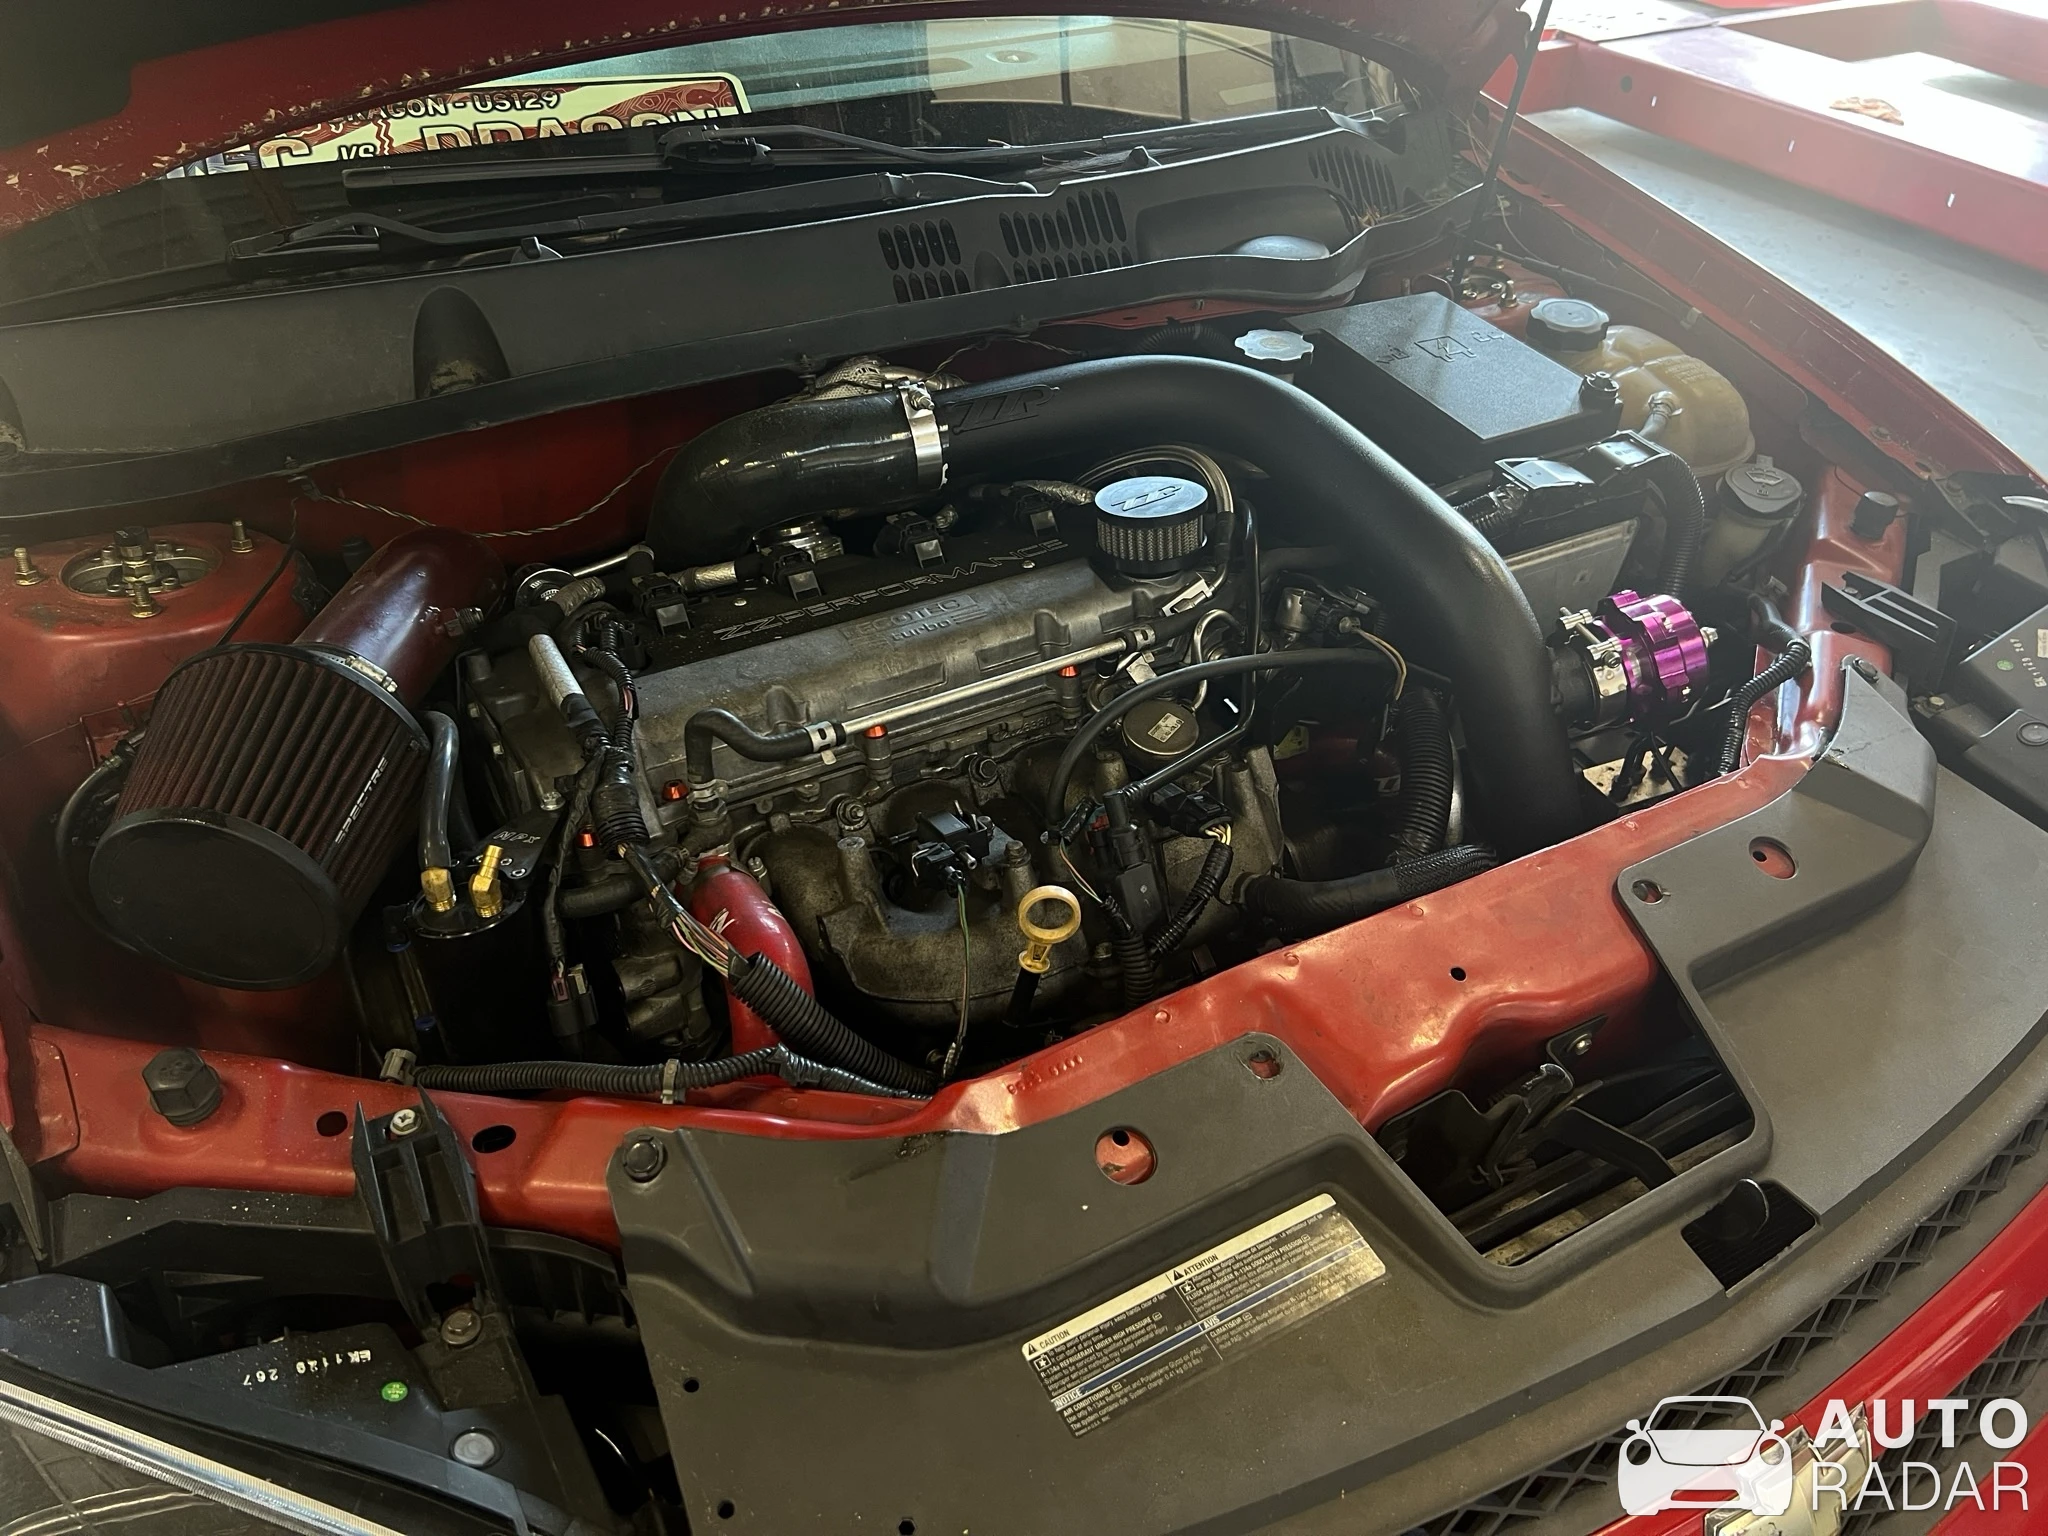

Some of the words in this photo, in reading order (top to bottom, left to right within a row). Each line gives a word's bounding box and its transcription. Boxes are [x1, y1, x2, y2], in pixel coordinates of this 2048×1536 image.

[472, 90, 558, 112] US129
[712, 538, 1069, 642] ZZPERFORMANCE
[891, 619, 951, 643] turbo
[334, 756, 389, 845] SPECTRE
[1182, 1253, 1219, 1276] ATTENTION
[1202, 1315, 1220, 1329] AVIS
[1038, 1328, 1070, 1349] CAUTION
[1058, 1345, 1095, 1368] REFRIGERANT
[1093, 1336, 1113, 1350] UNDER
[1111, 1329, 1126, 1341] HIGH
[1124, 1316, 1152, 1334] PRESSURE
[1055, 1388, 1082, 1407] NOTICE
[1062, 1406, 1073, 1416] AIR
[1072, 1387, 1111, 1411] CONDITIONING
